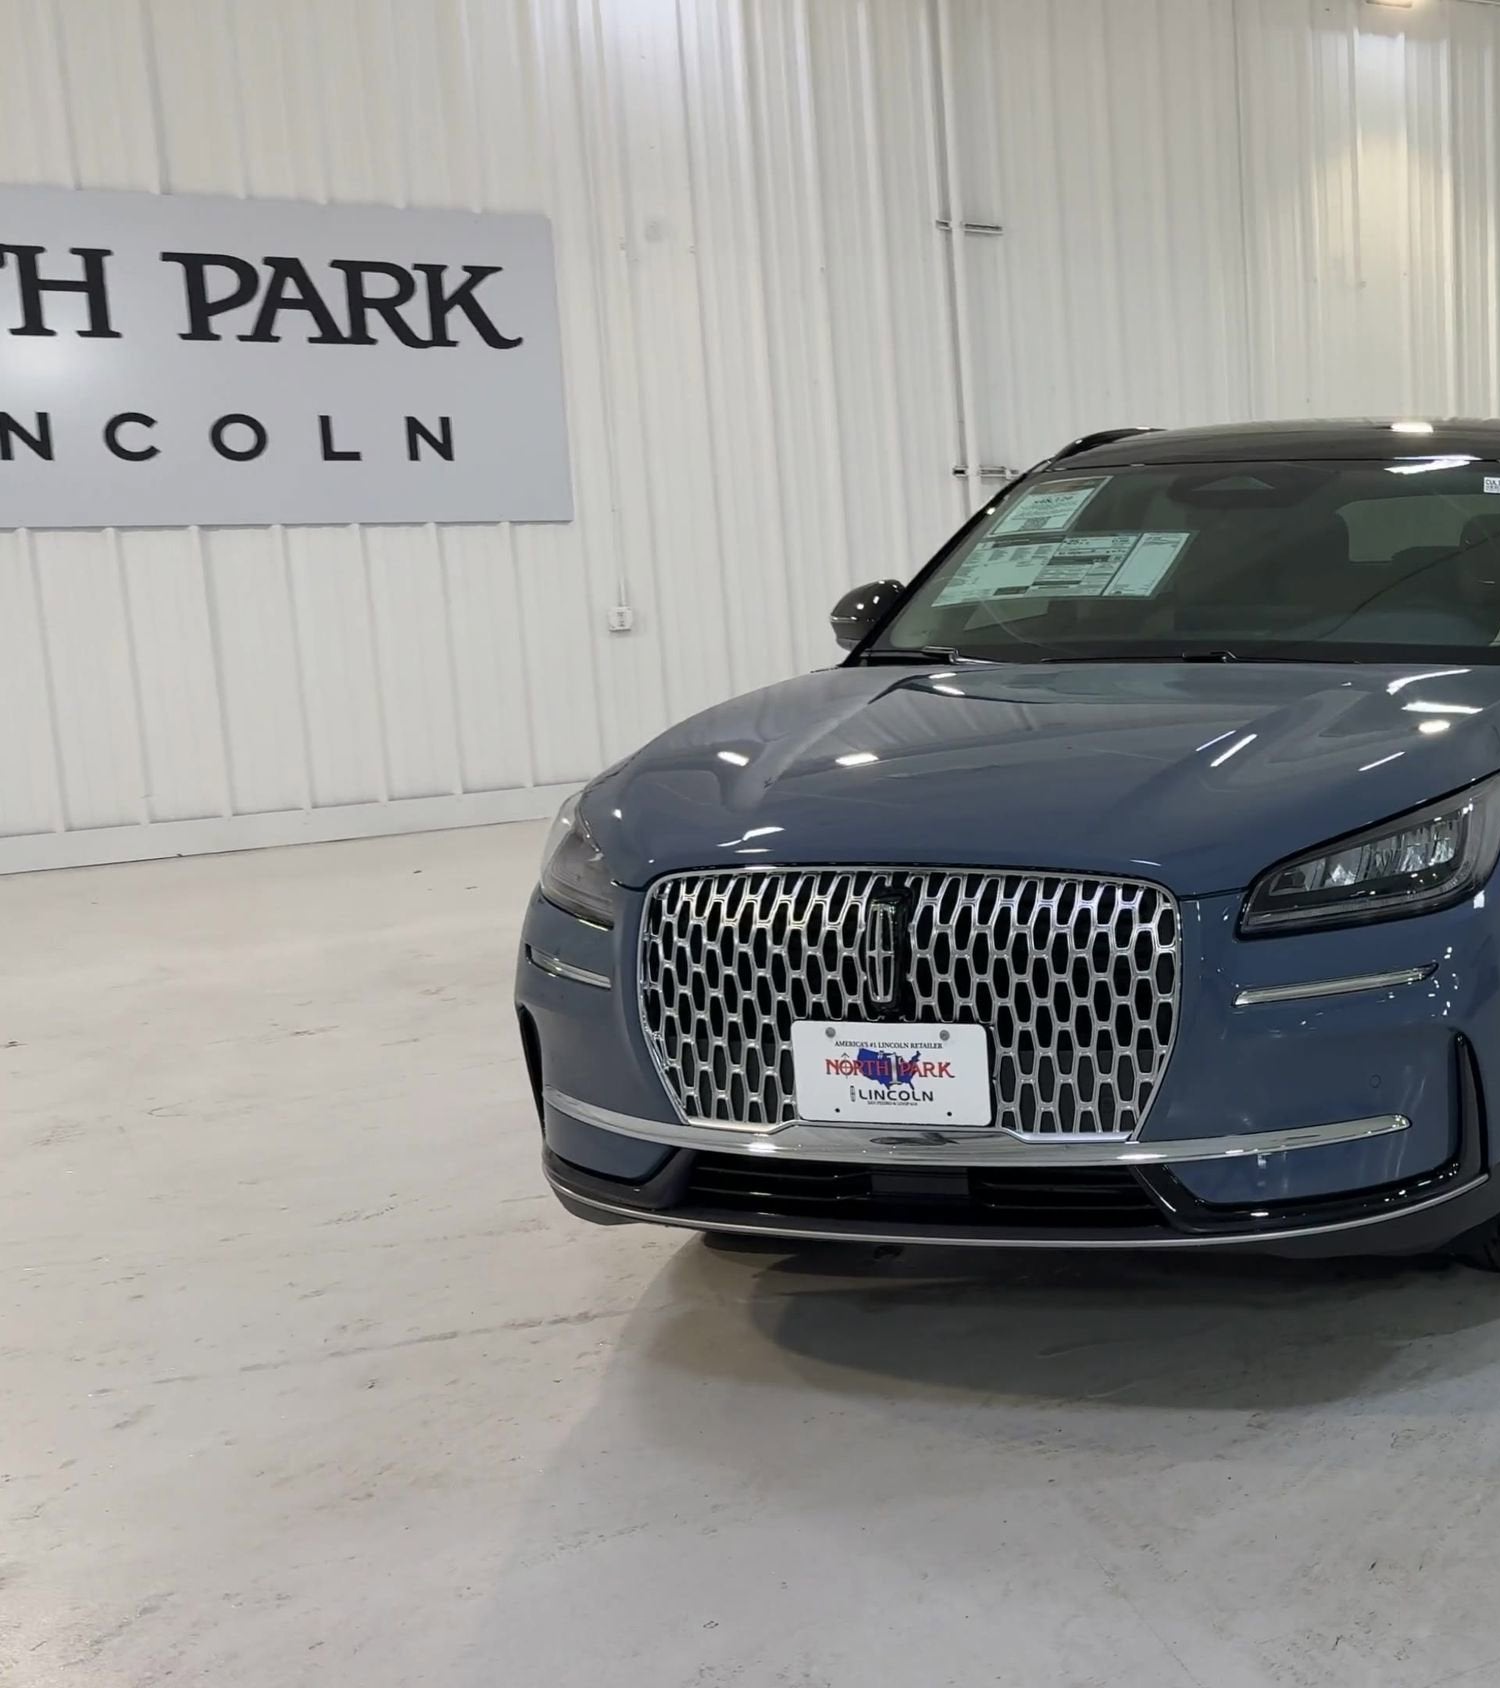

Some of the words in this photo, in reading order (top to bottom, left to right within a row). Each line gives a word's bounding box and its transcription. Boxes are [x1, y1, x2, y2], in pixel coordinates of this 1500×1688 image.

[160, 251, 523, 349] PARK
[834, 1040, 869, 1049] AMERICA'S
[878, 1041, 909, 1049] LINCOLN
[910, 1042, 943, 1050] RETAILER
[825, 1058, 889, 1077] NORTH
[900, 1060, 956, 1079] PARK
[858, 1088, 934, 1102] LINCOLN
